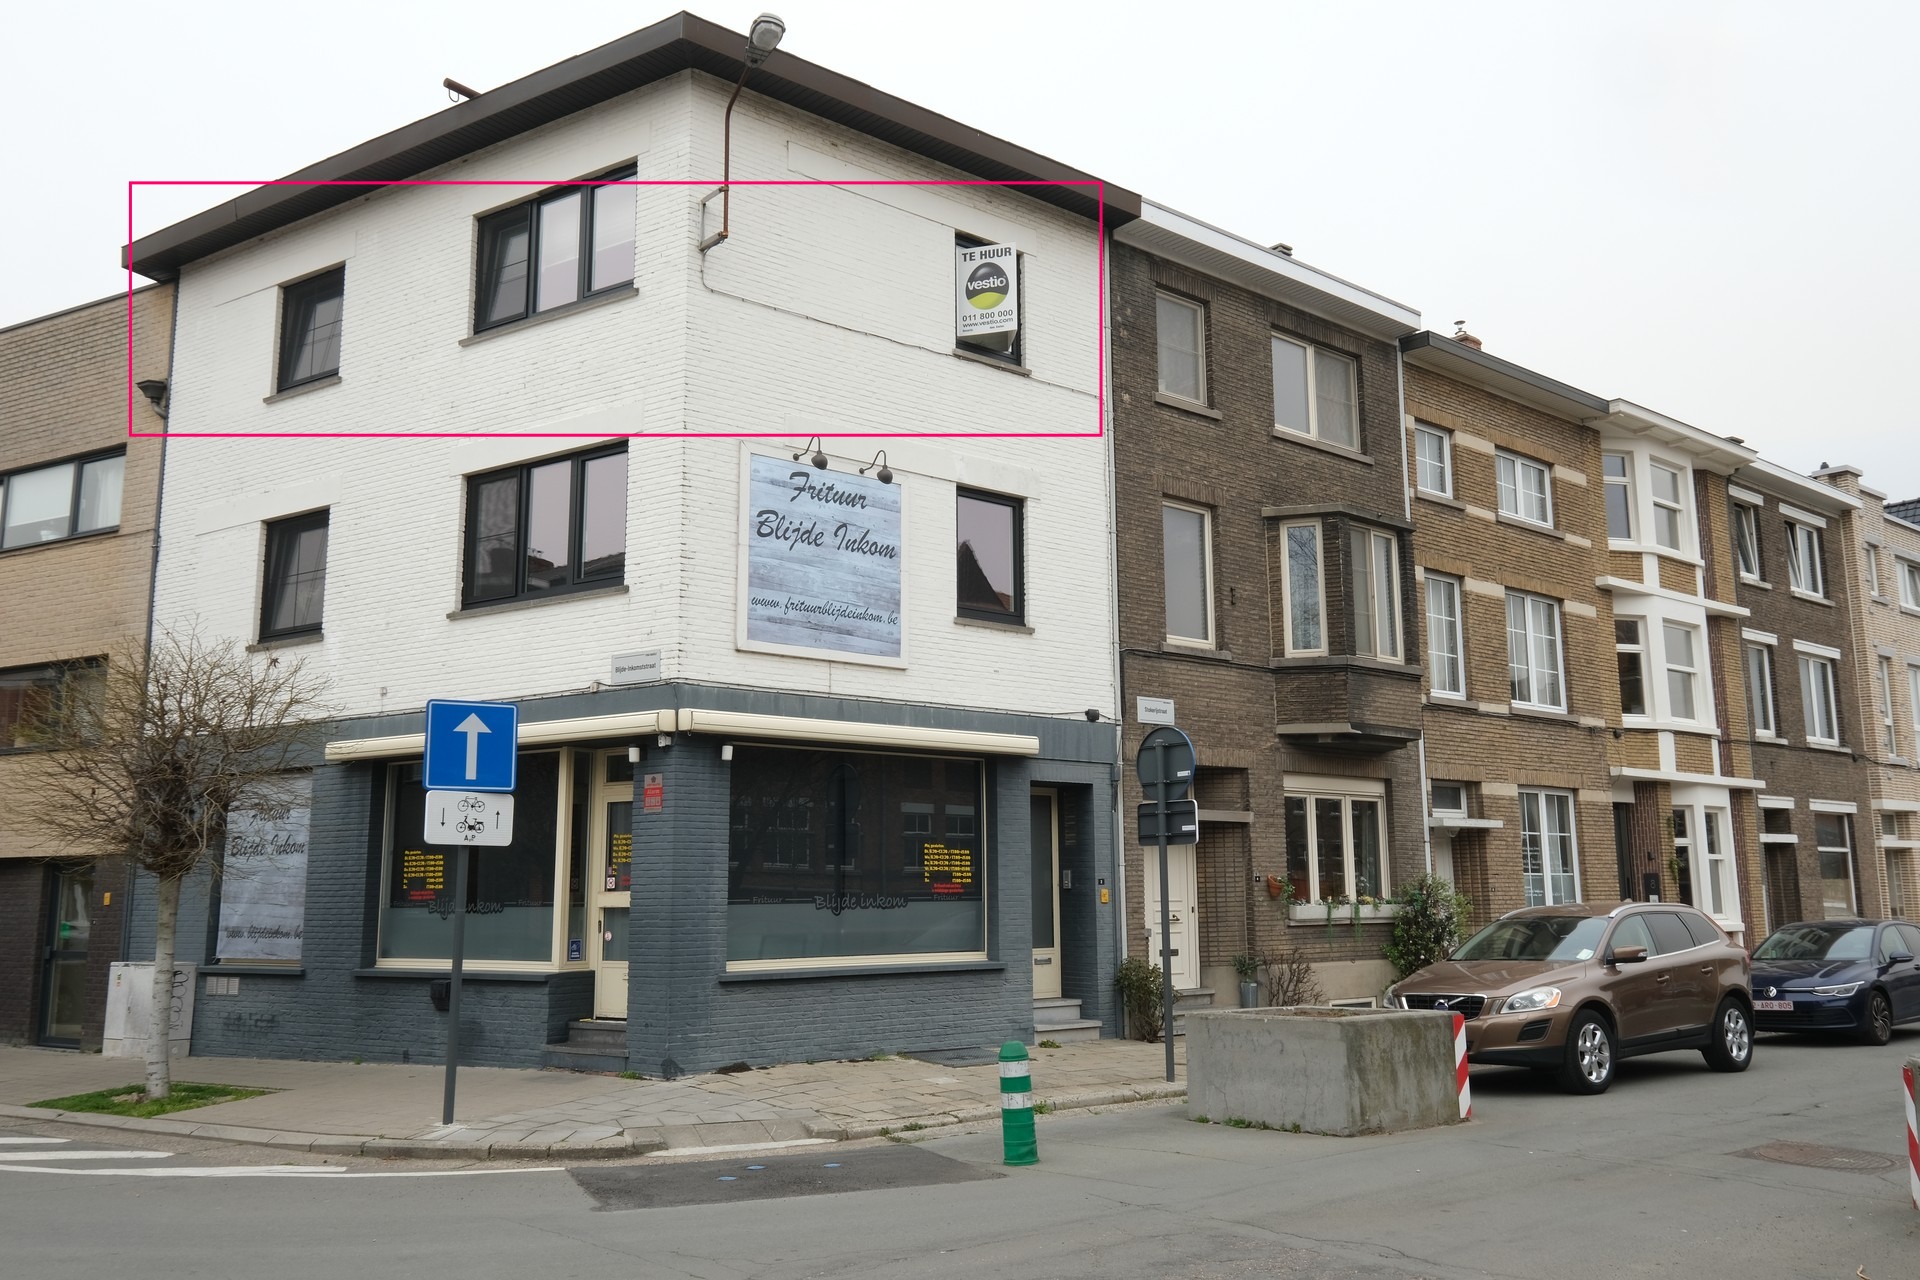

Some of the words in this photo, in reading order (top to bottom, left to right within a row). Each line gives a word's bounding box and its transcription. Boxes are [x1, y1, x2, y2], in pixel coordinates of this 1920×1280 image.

[962, 252, 976, 262] TE
[980, 247, 1012, 260] HUUR
[967, 276, 1006, 290] vestio
[962, 314, 977, 322] 011
[980, 311, 995, 320] 800
[997, 309, 1013, 318] 000
[962, 317, 1013, 328] www.vestio.com
[789, 471, 867, 509] Frituur
[756, 509, 825, 551] Blijde
[834, 523, 896, 559] Inkom
[751, 596, 898, 625] www.frituurblijdeinkom.be
[230, 835, 266, 862] Blijde
[270, 833, 305, 856] Inkom
[428, 897, 456, 919] Blijd
[464, 898, 504, 914] nkom
[752, 895, 783, 904] Frituur
[814, 893, 857, 915] Blijde
[860, 893, 907, 909] inkom
